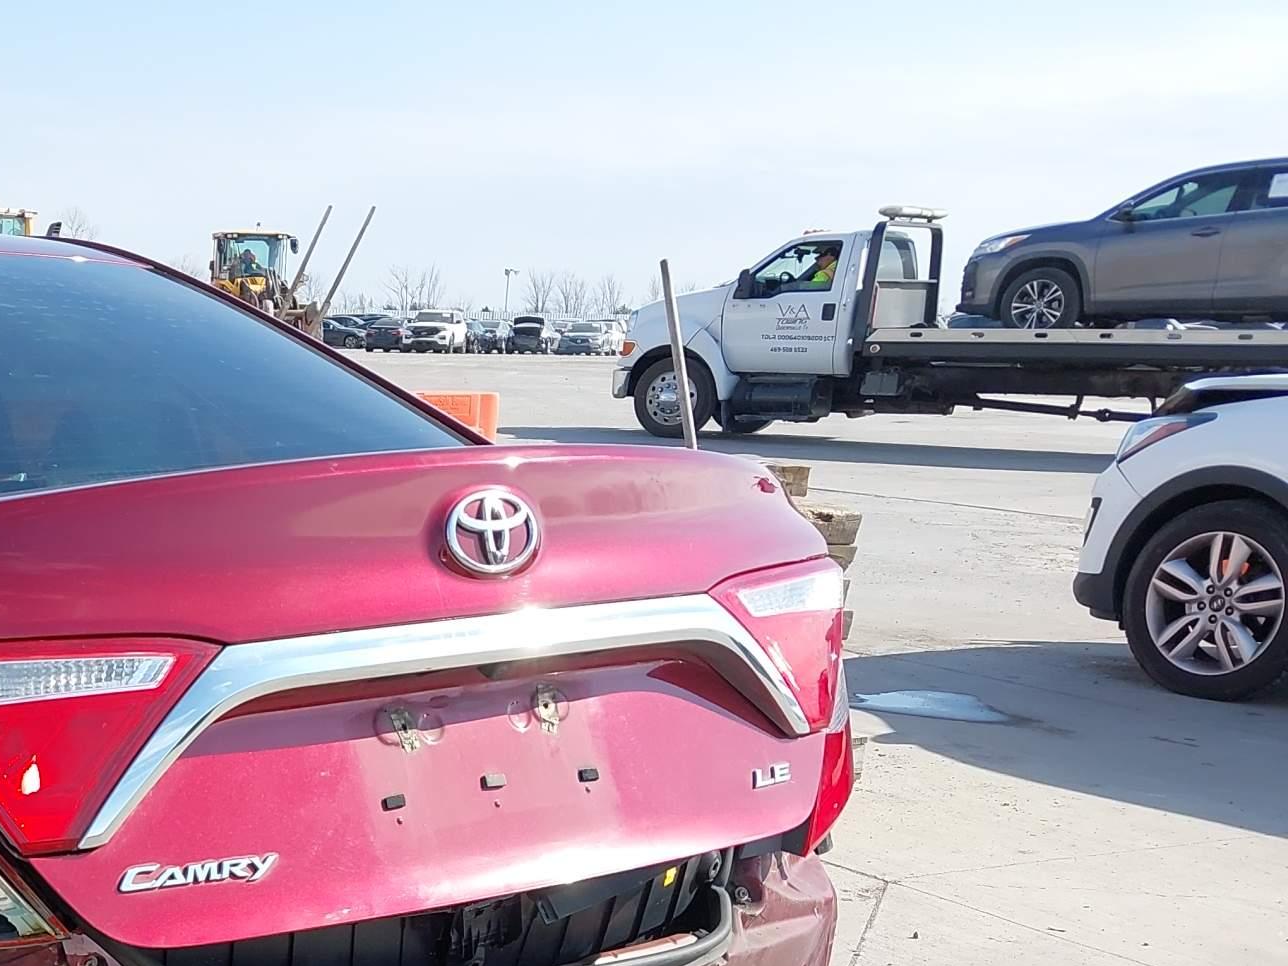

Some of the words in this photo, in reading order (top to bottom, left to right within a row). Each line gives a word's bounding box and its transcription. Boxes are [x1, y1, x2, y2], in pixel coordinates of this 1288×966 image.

[777, 303, 810, 320] V&A
[752, 762, 792, 790] LE
[117, 852, 279, 894] CAMRY
